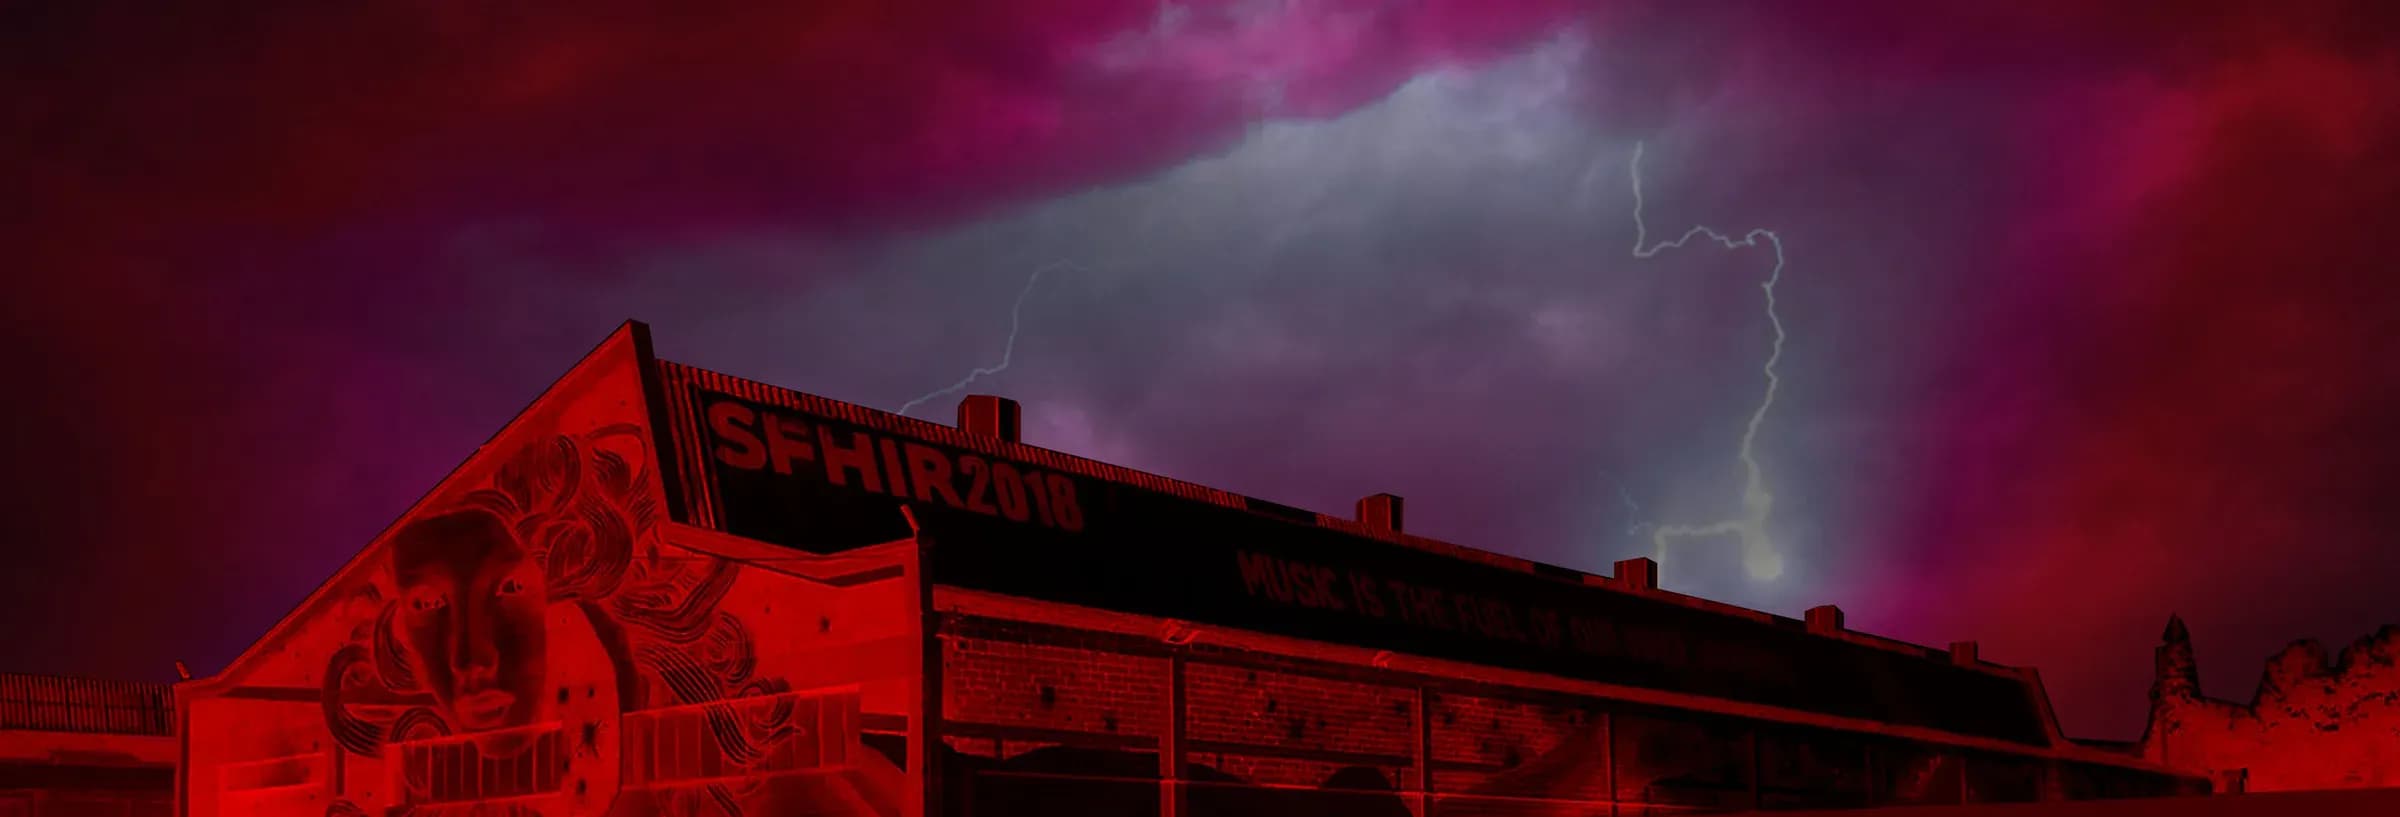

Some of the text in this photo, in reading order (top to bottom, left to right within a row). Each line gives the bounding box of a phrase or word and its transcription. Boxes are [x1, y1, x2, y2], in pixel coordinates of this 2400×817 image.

[708, 401, 1086, 533] SFHIR2018
[1236, 552, 1343, 609] MUSIC
[1348, 569, 1384, 617] IS
[1388, 578, 1451, 629] THE
